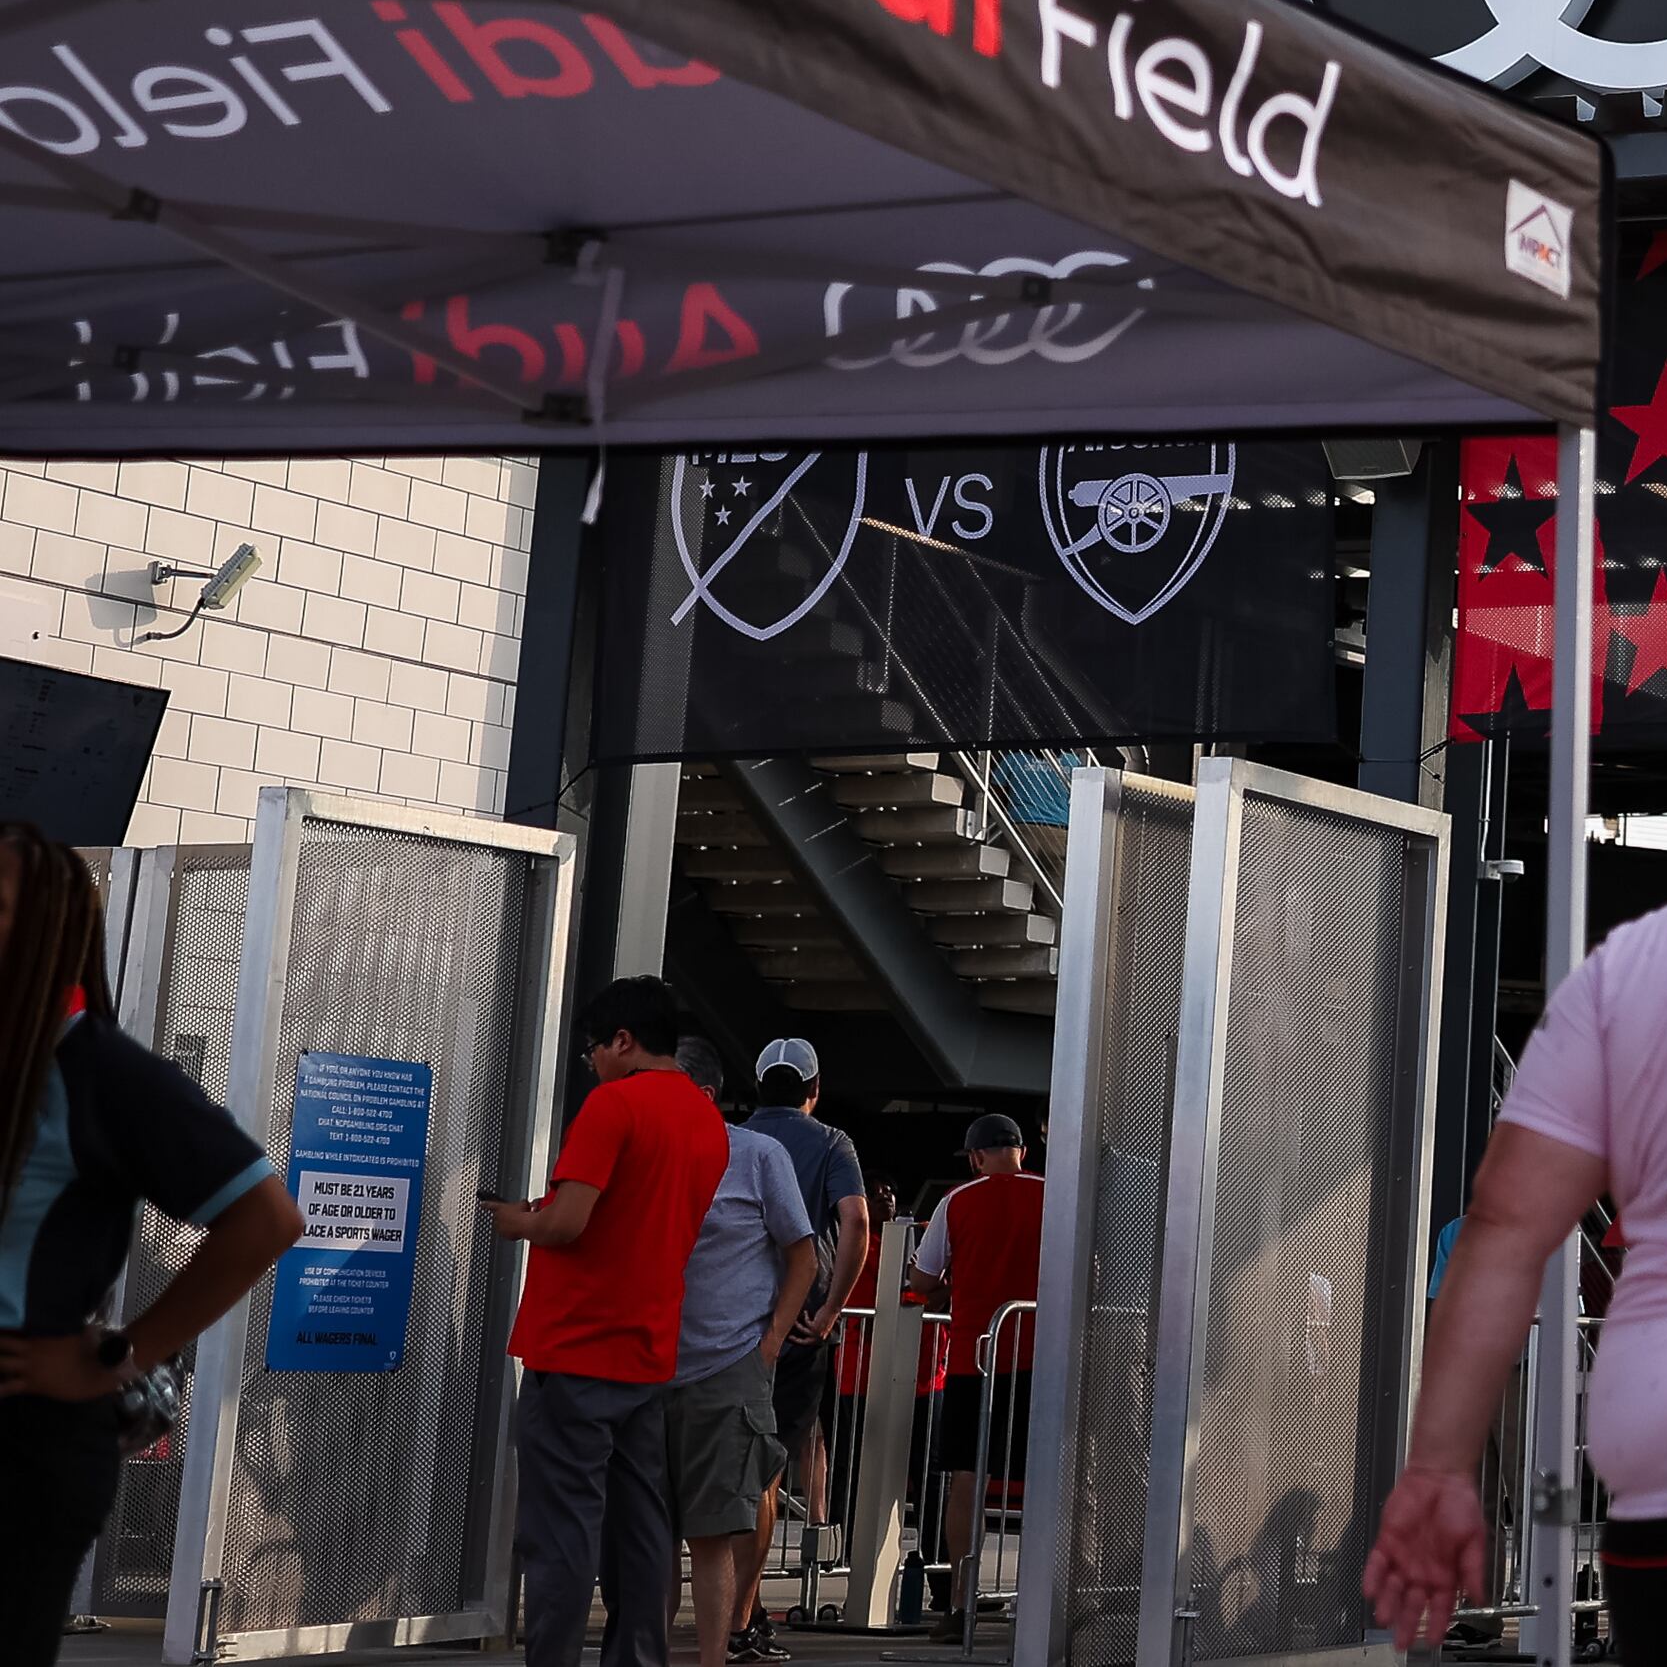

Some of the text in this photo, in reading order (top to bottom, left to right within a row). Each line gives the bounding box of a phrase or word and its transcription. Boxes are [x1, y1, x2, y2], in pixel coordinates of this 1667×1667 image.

[903, 472, 995, 541] VS
[314, 1182, 394, 1199] MUST BE 21 YEARS
[309, 1203, 396, 1220] OF AGE OR OLDER TO
[304, 1224, 401, 1242] LACE A SPORTS WAGER
[296, 1333, 312, 1345] ALL
[352, 1332, 378, 1345] FINAL
